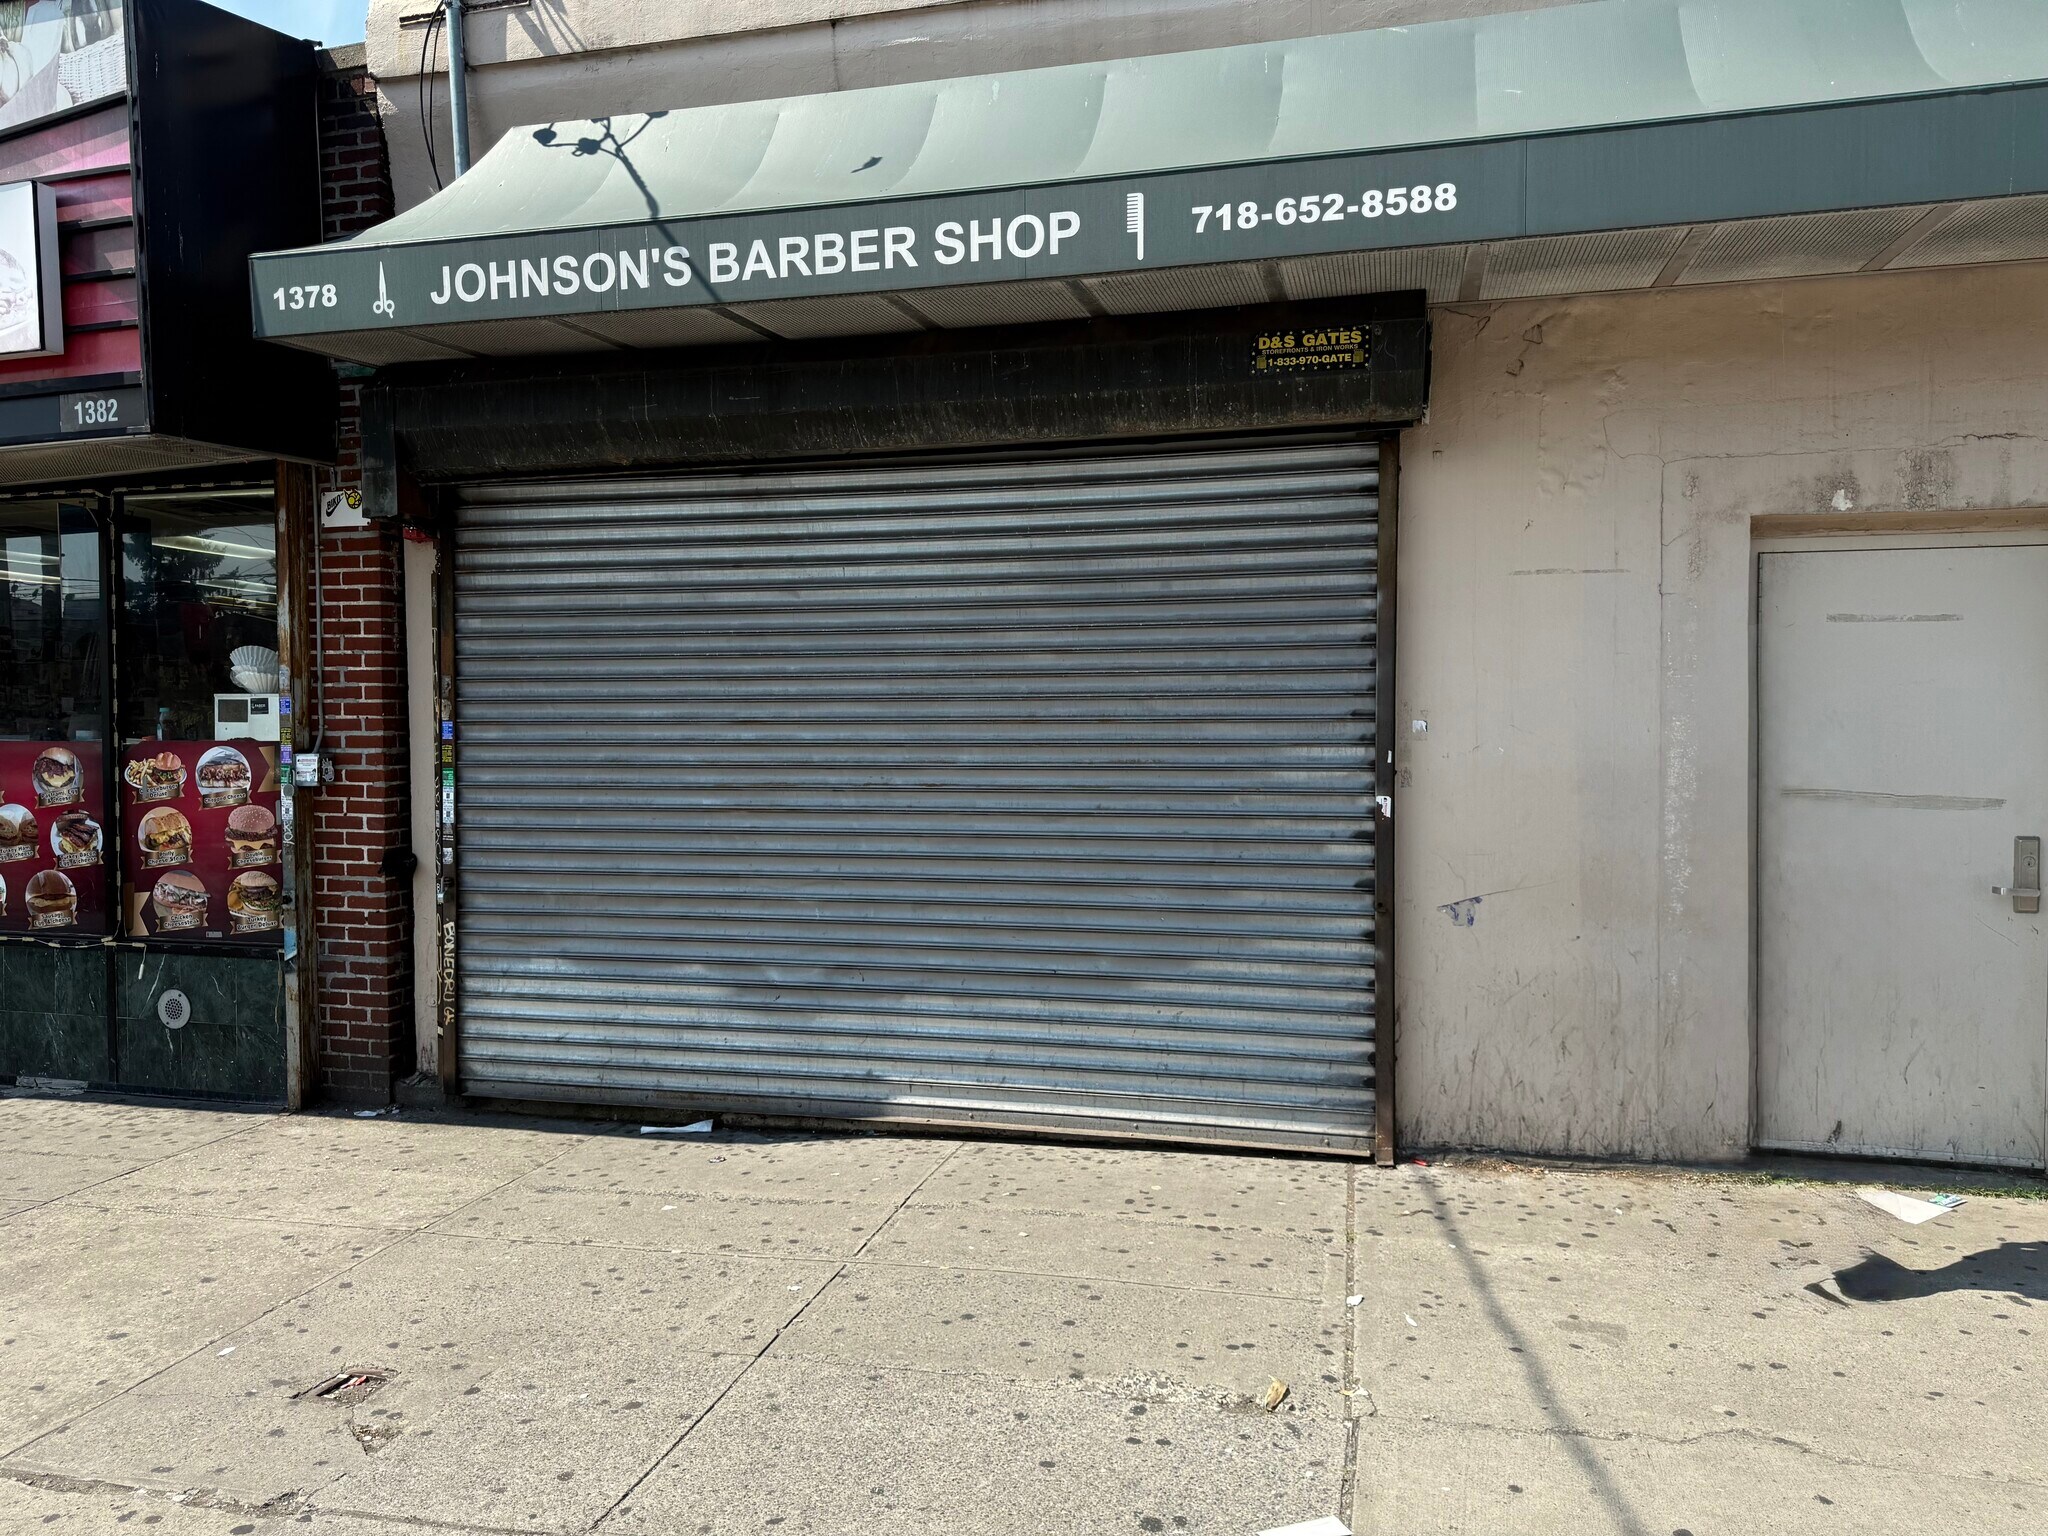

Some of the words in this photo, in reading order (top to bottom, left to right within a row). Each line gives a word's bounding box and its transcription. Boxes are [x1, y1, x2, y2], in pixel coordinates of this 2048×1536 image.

[1191, 182, 1458, 234] 718-652-8588
[429, 245, 693, 305] JOHNSON'S
[708, 226, 919, 284] BARBER
[933, 210, 1081, 266] SHOP
[273, 283, 338, 311] 1378
[1258, 335, 1296, 350] D&S
[1302, 330, 1362, 347] GATES
[1261, 346, 1309, 355] STOREFRONTS
[1334, 343, 1359, 351] WORKS
[1267, 353, 1352, 367] 1-833-970-GATE
[73, 398, 119, 425] 1382
[139, 784, 178, 794] Ceeseburger
[204, 795, 226, 804] Chopped
[236, 923, 256, 931] Burger
